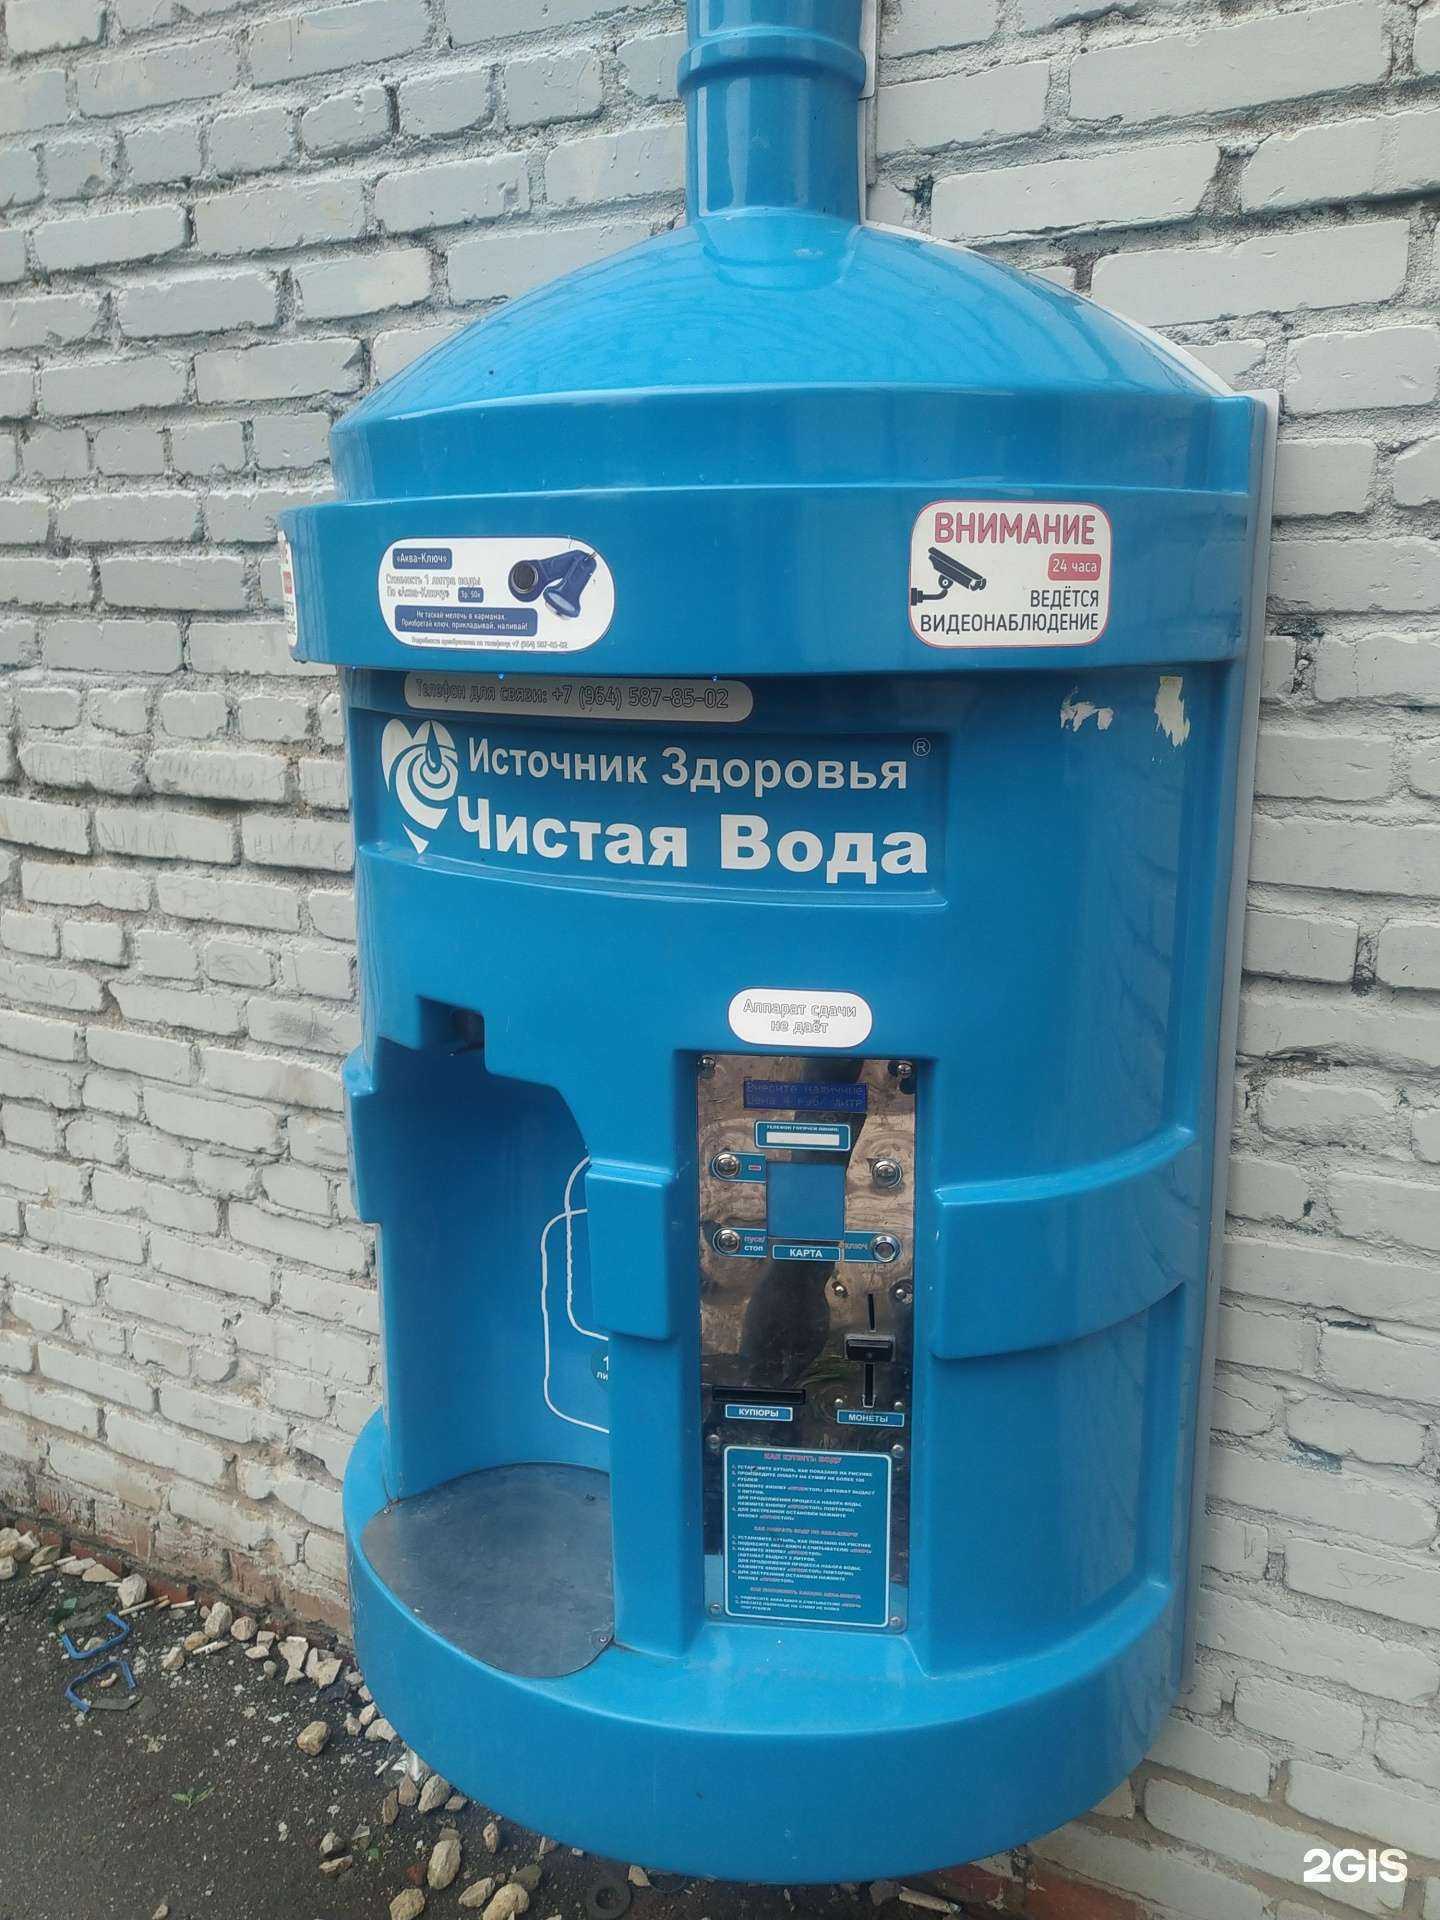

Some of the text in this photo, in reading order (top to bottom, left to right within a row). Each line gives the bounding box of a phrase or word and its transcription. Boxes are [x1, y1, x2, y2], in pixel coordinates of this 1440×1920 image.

[934, 512, 1096, 545] ВНИМАНИЕ
[1052, 558, 1097, 573] 24 часа
[1030, 586, 1099, 610] ВЕДЁТСЯ
[920, 613, 1099, 635] ВИДЕОНАБЛЮДЕНИЕ
[415, 678, 729, 711] Телефон для связи: +7 (964) 587-85-02
[467, 736, 648, 784] Источник
[661, 746, 908, 798] Здоровья
[457, 795, 929, 884] Чистая Вода
[743, 999, 857, 1019] Аппарат сдачи
[770, 1019, 829, 1035] не даёт
[789, 1248, 823, 1258] КАРТА
[738, 1408, 780, 1418] КУПЮРЫ
[848, 1413, 889, 1424] МОНЕТЫ
